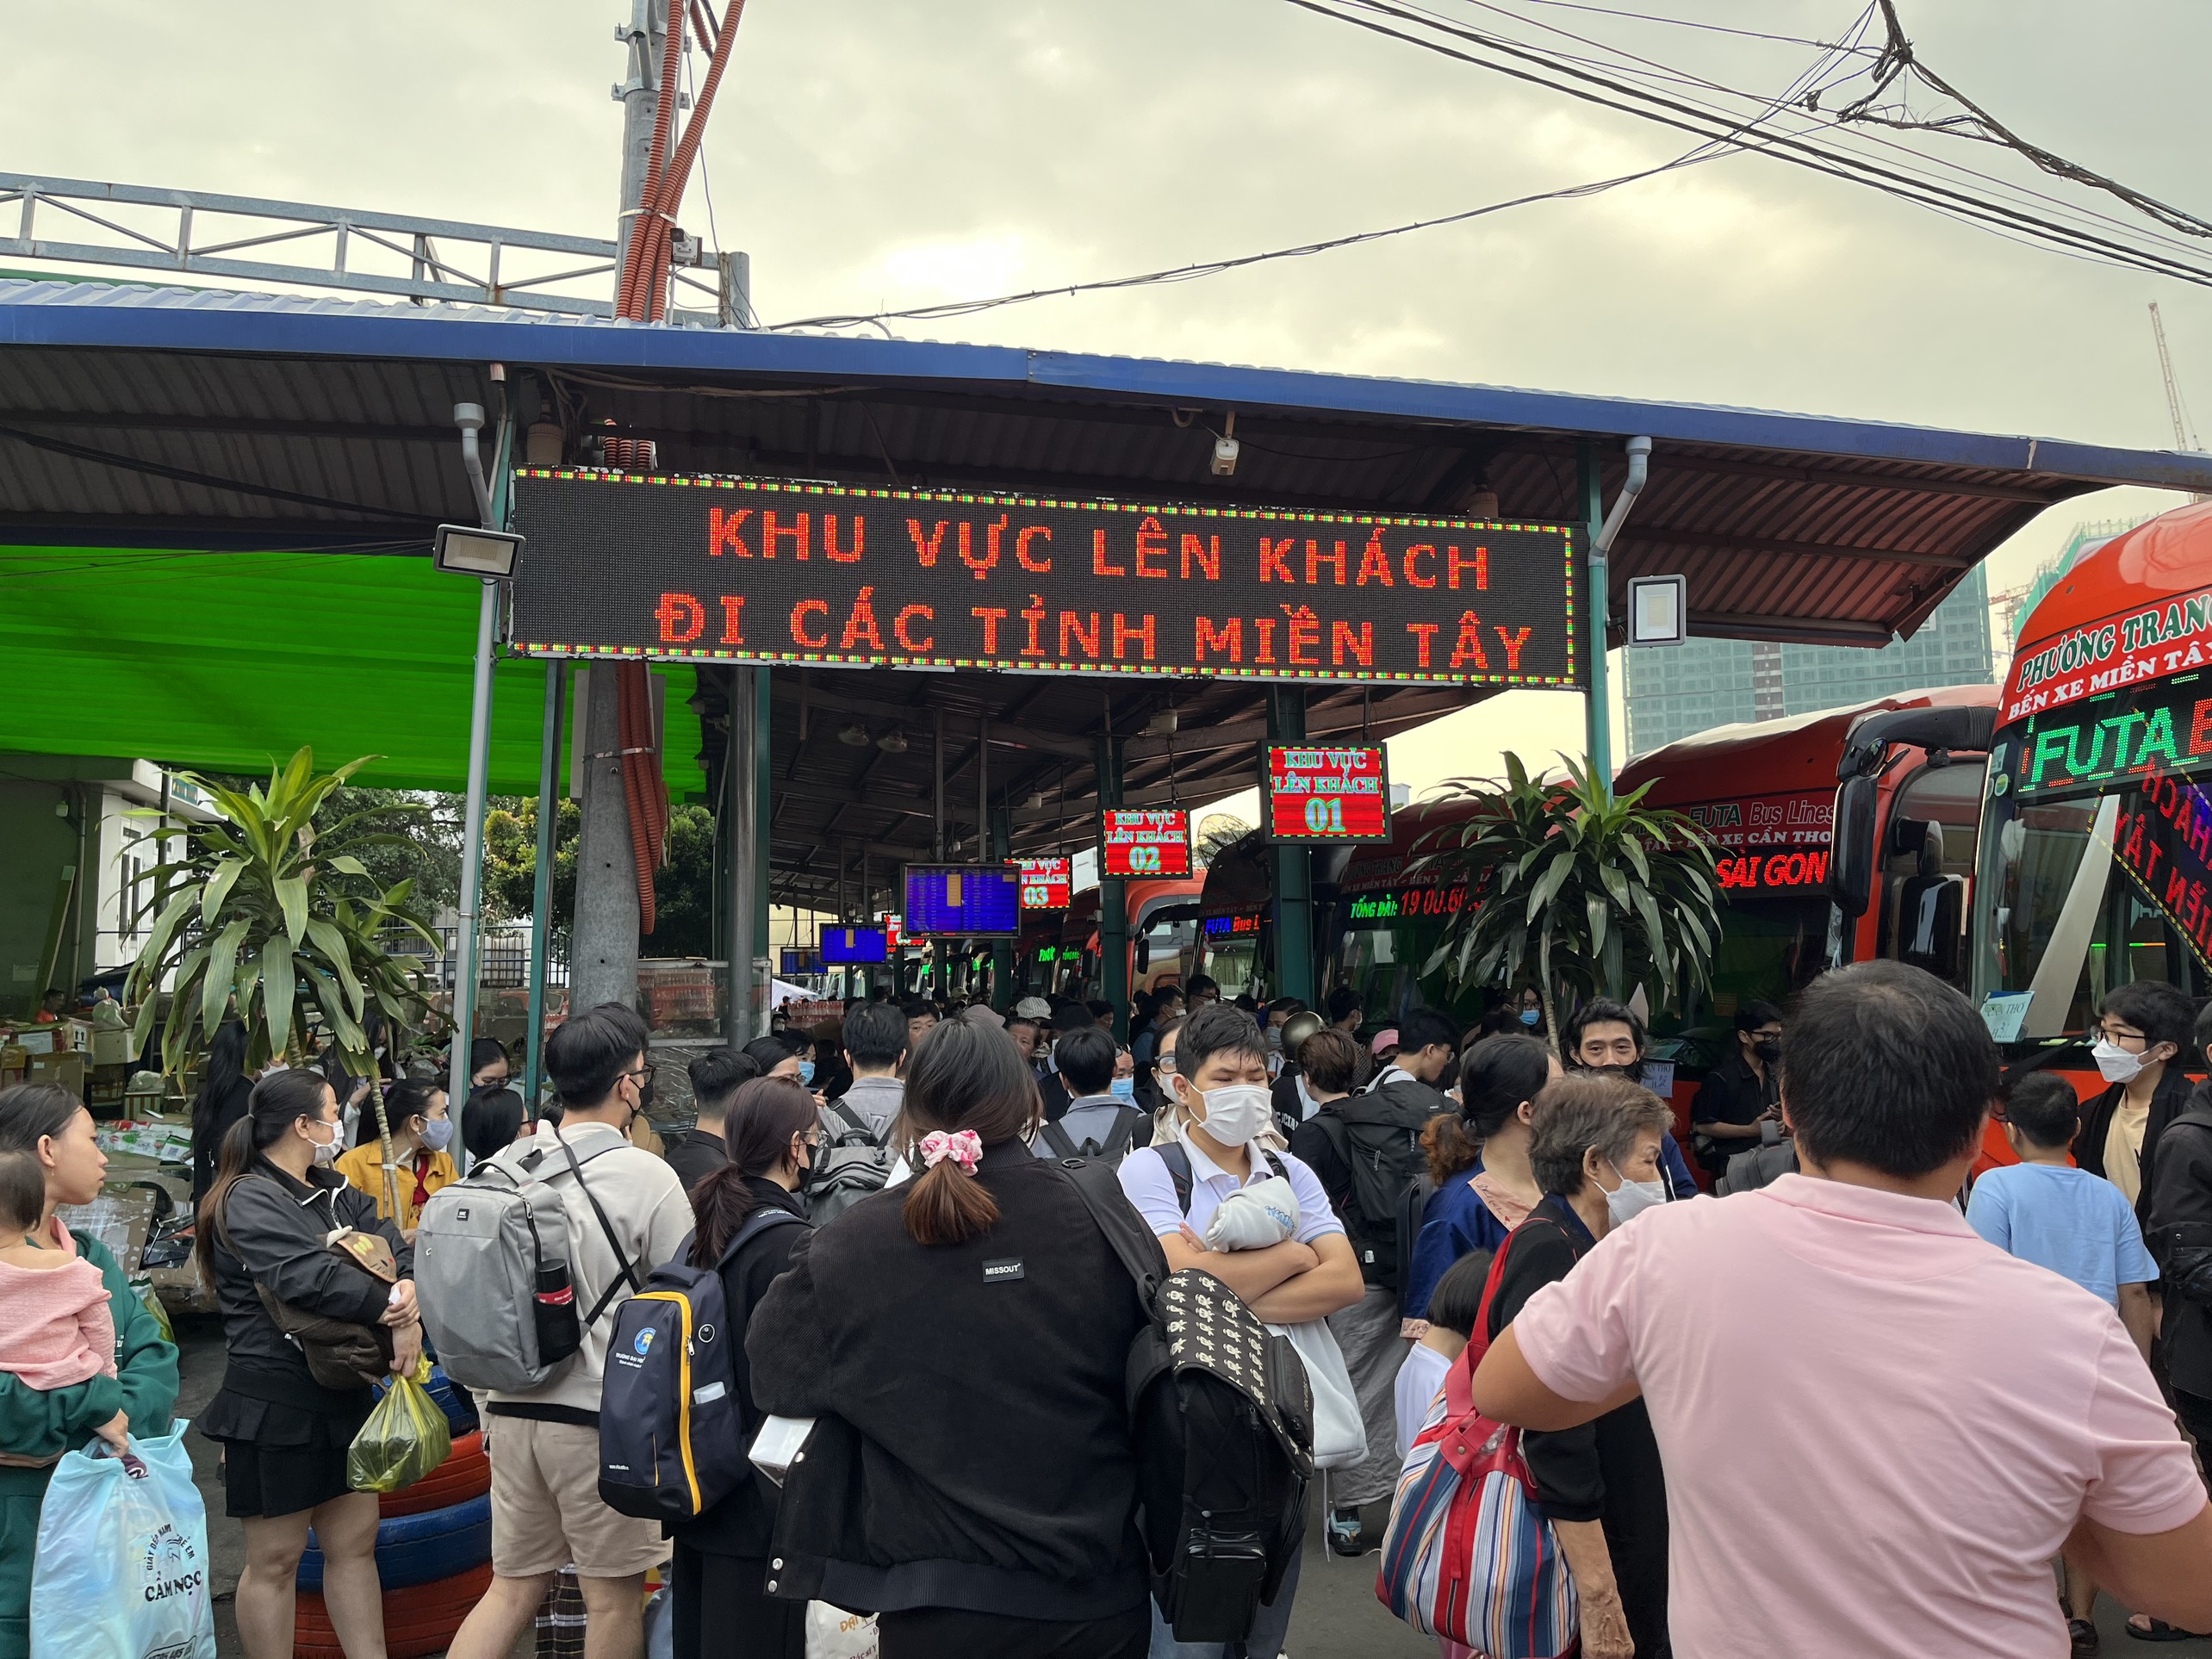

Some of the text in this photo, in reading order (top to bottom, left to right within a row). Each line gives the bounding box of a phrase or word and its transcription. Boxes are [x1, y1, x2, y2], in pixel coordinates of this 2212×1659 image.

[710, 507, 1488, 590] KHU VỰC LÊN KHÁCH
[655, 586, 1532, 670] ĐI CÁC TỈNH MIỀN TÂY
[2016, 594, 2212, 693] PHƯƠNG TRAN
[2007, 689, 2049, 720] BẾN
[2051, 679, 2085, 704] XE
[2089, 655, 2158, 692] MIỀN
[2031, 706, 2178, 783] FUTA
[1283, 751, 1324, 769] KHU
[1273, 771, 1379, 794] LÊN KHÁCH
[1115, 813, 1144, 825] KHU
[1305, 798, 1345, 832] 01
[1687, 803, 1742, 830] FUTA
[1749, 802, 1783, 826] Bus
[1106, 827, 1184, 843] LÊN KHÁCH
[1721, 833, 1744, 845] XE
[1748, 827, 1787, 843] CẦN
[1129, 847, 1161, 871] 02
[1023, 886, 1049, 905] 03
[1205, 916, 1231, 934] FUTA
[1233, 916, 1252, 932] Bus
[985, 1264, 1019, 1275] MISSOUT
[184, 1547, 195, 1560] EM
